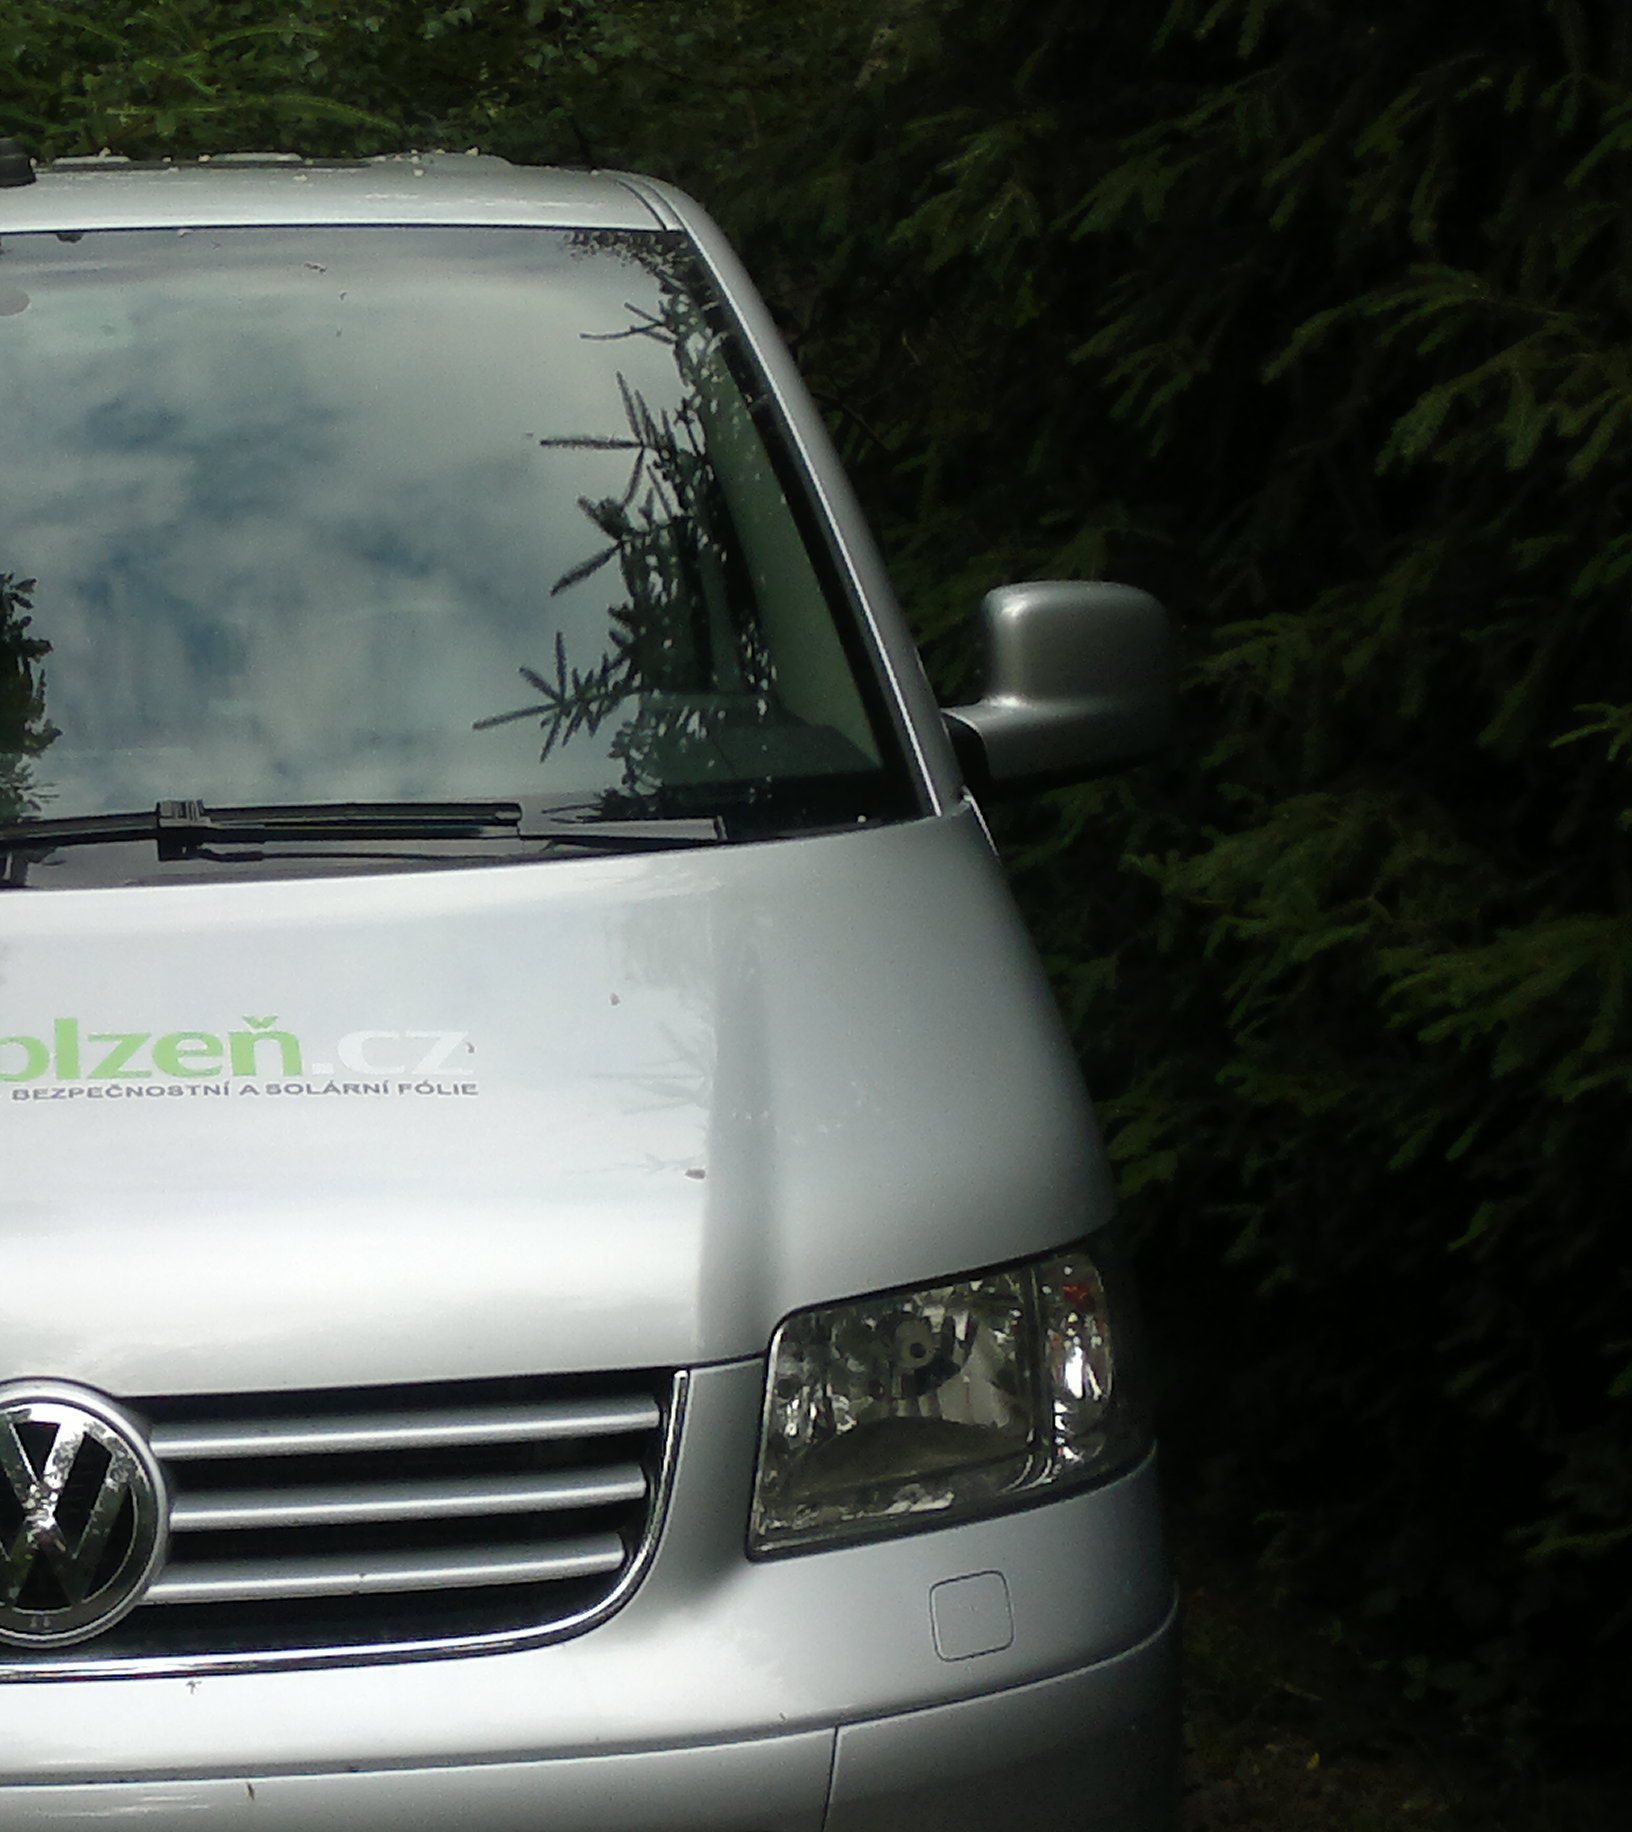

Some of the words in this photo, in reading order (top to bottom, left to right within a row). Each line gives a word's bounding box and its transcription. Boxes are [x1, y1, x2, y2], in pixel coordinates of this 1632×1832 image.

[12, 1081, 230, 1101] BEZPEČNOSTNÍ
[239, 1083, 261, 1096] A
[265, 1080, 389, 1096] SOLÁRNÍ
[397, 1080, 479, 1096] FÓLIE
